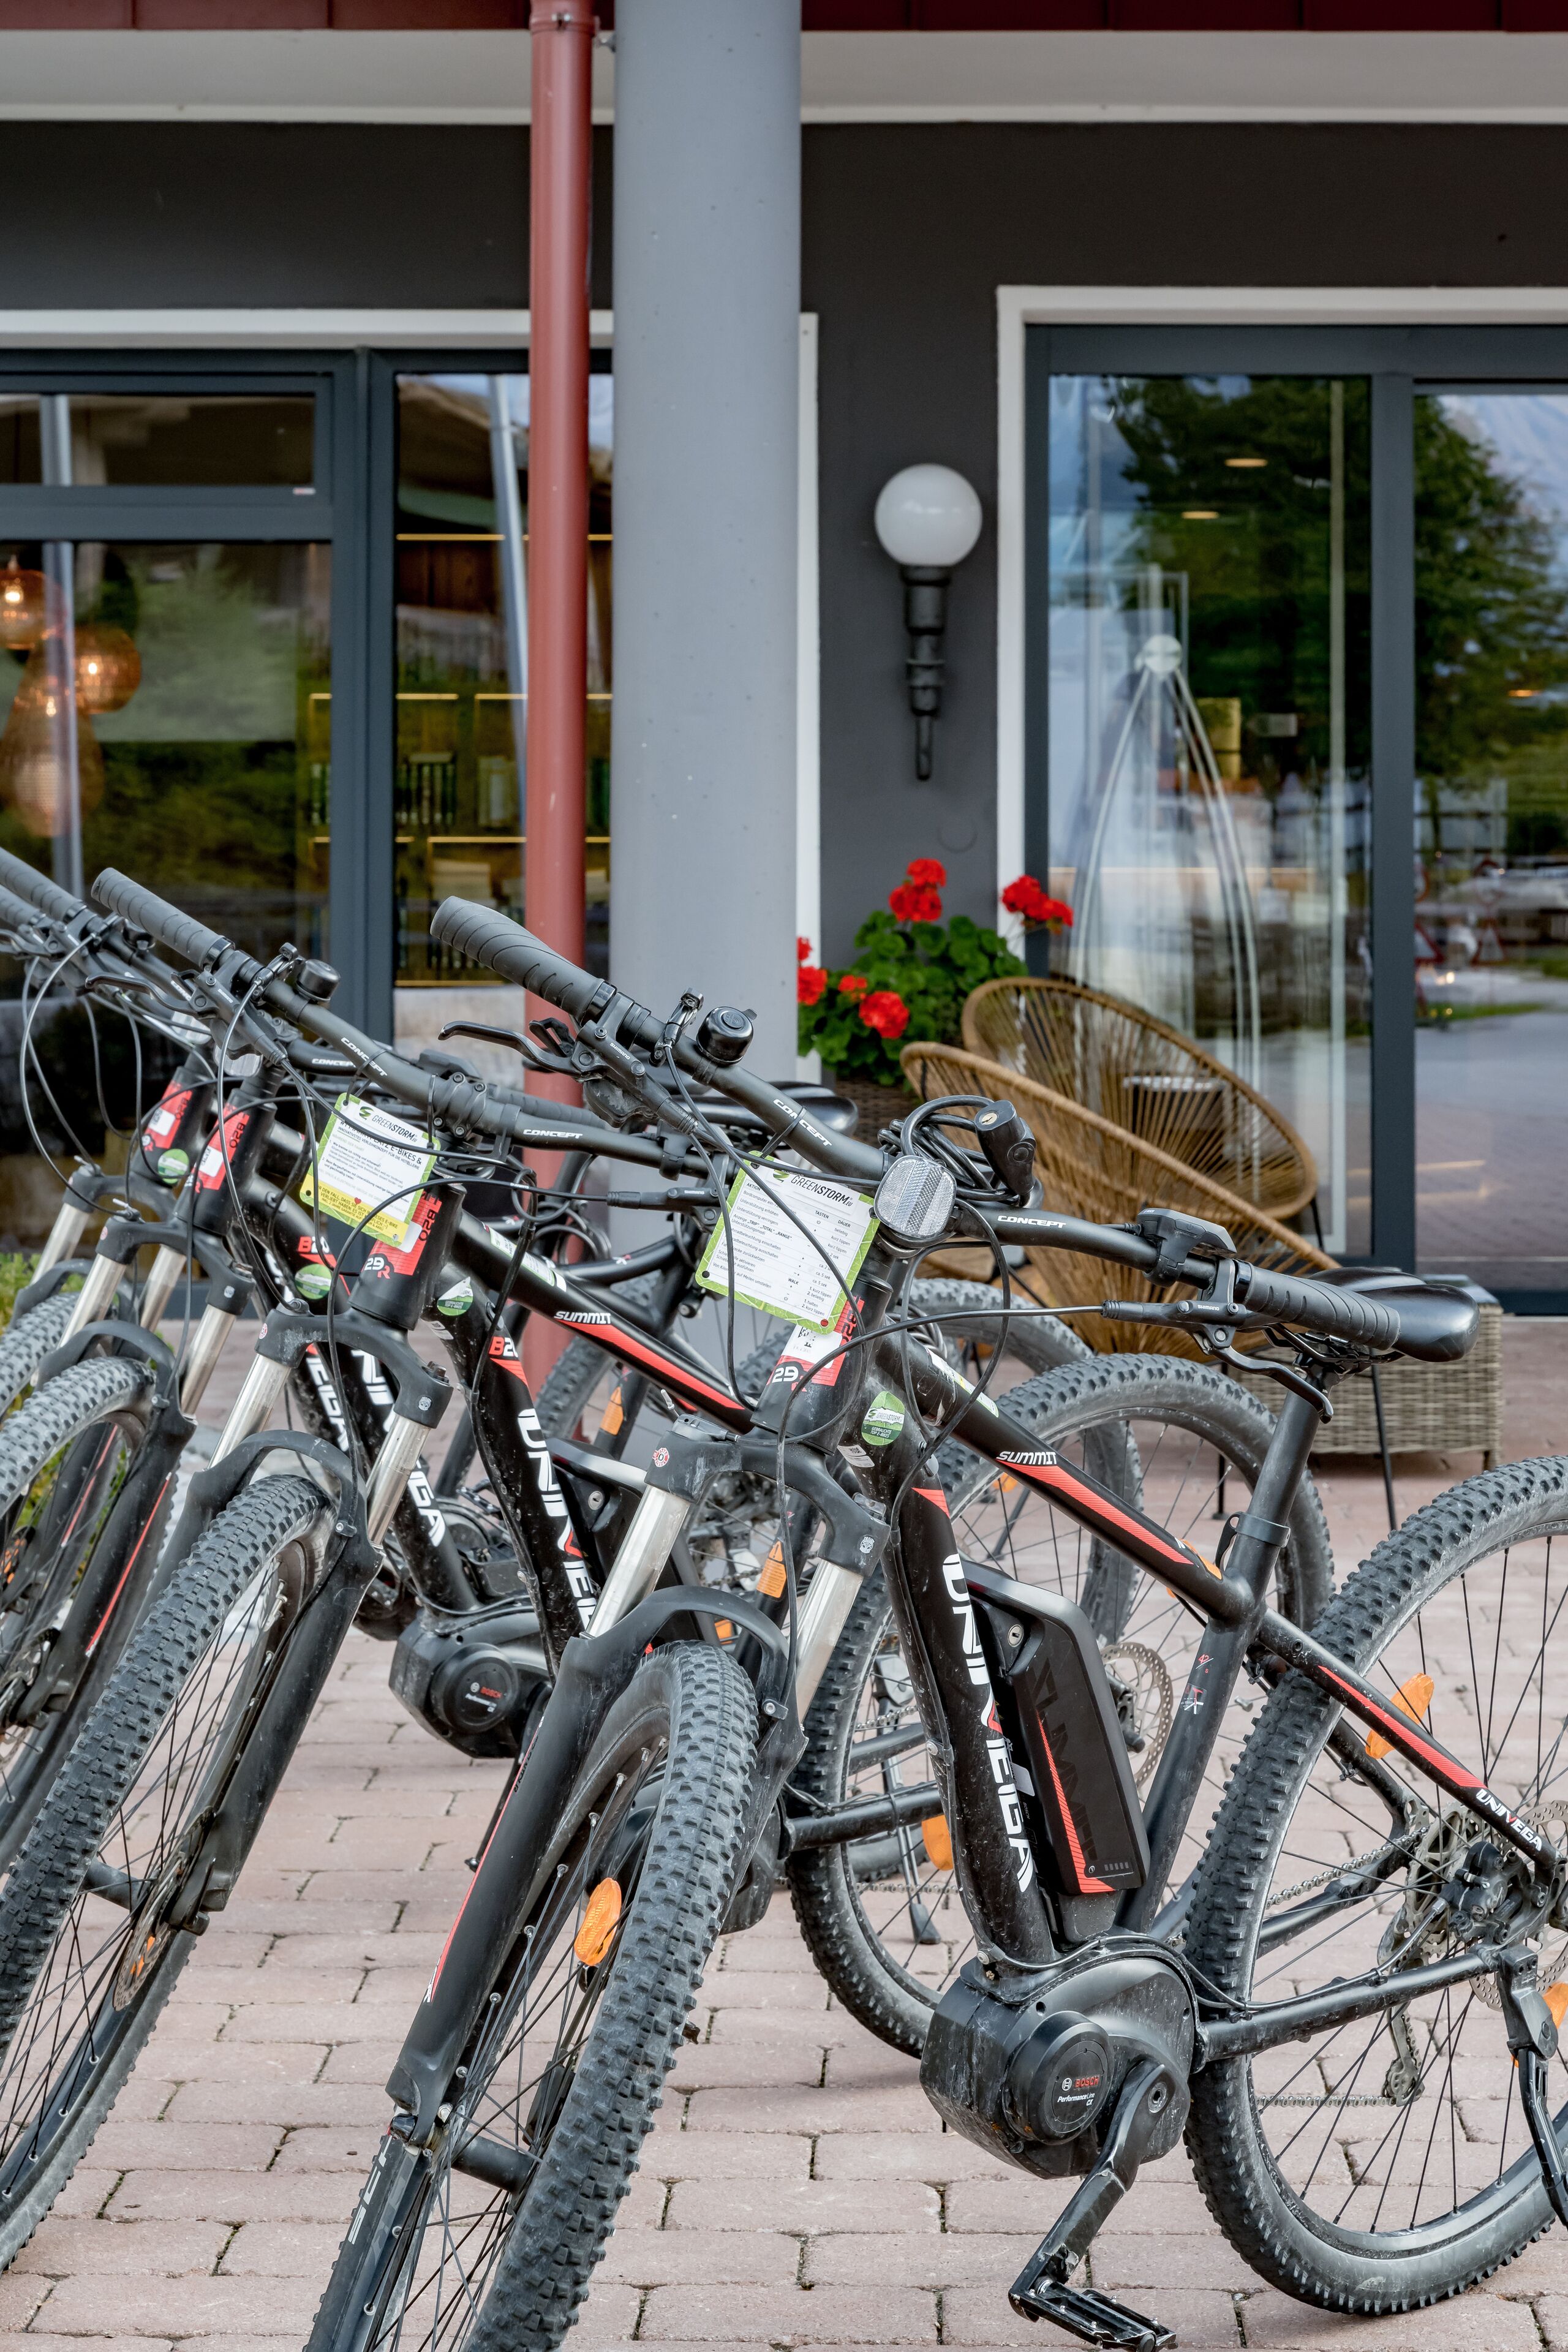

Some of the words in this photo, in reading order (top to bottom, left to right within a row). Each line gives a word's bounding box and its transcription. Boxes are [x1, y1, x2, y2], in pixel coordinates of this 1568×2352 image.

[341, 1038, 388, 1076] CONCEPT
[609, 1042, 630, 1060] SHIMANO
[774, 1099, 832, 1146] CONCEPT
[230, 1122, 244, 1148] B20
[523, 1129, 582, 1139] CONCEPT
[746, 1182, 761, 1191] AKTION
[736, 1205, 761, 1219] Unterstützung
[739, 1198, 764, 1211] Unterstützung
[764, 1208, 779, 1216] erhöhen
[814, 1210, 829, 1219] TASTEN
[418, 1208, 435, 1241] B20
[998, 1215, 1066, 1228] CONCEPT
[834, 1227, 848, 1236] beliebig
[838, 1238, 851, 1246] tippen
[834, 1246, 847, 1254] tippen
[810, 1292, 824, 1302] beliebig
[820, 1291, 832, 1299] tippen
[554, 1311, 611, 1324] SUMMIT
[772, 1366, 798, 1383] 29
[996, 1451, 1057, 1464] SUMMIT
[1198, 1654, 1209, 1664] 42
[942, 1553, 1034, 1893] UNIVEGA
[1476, 1789, 1542, 1851] UNIVEGA
[1074, 2076, 1099, 2088] BOSCH
